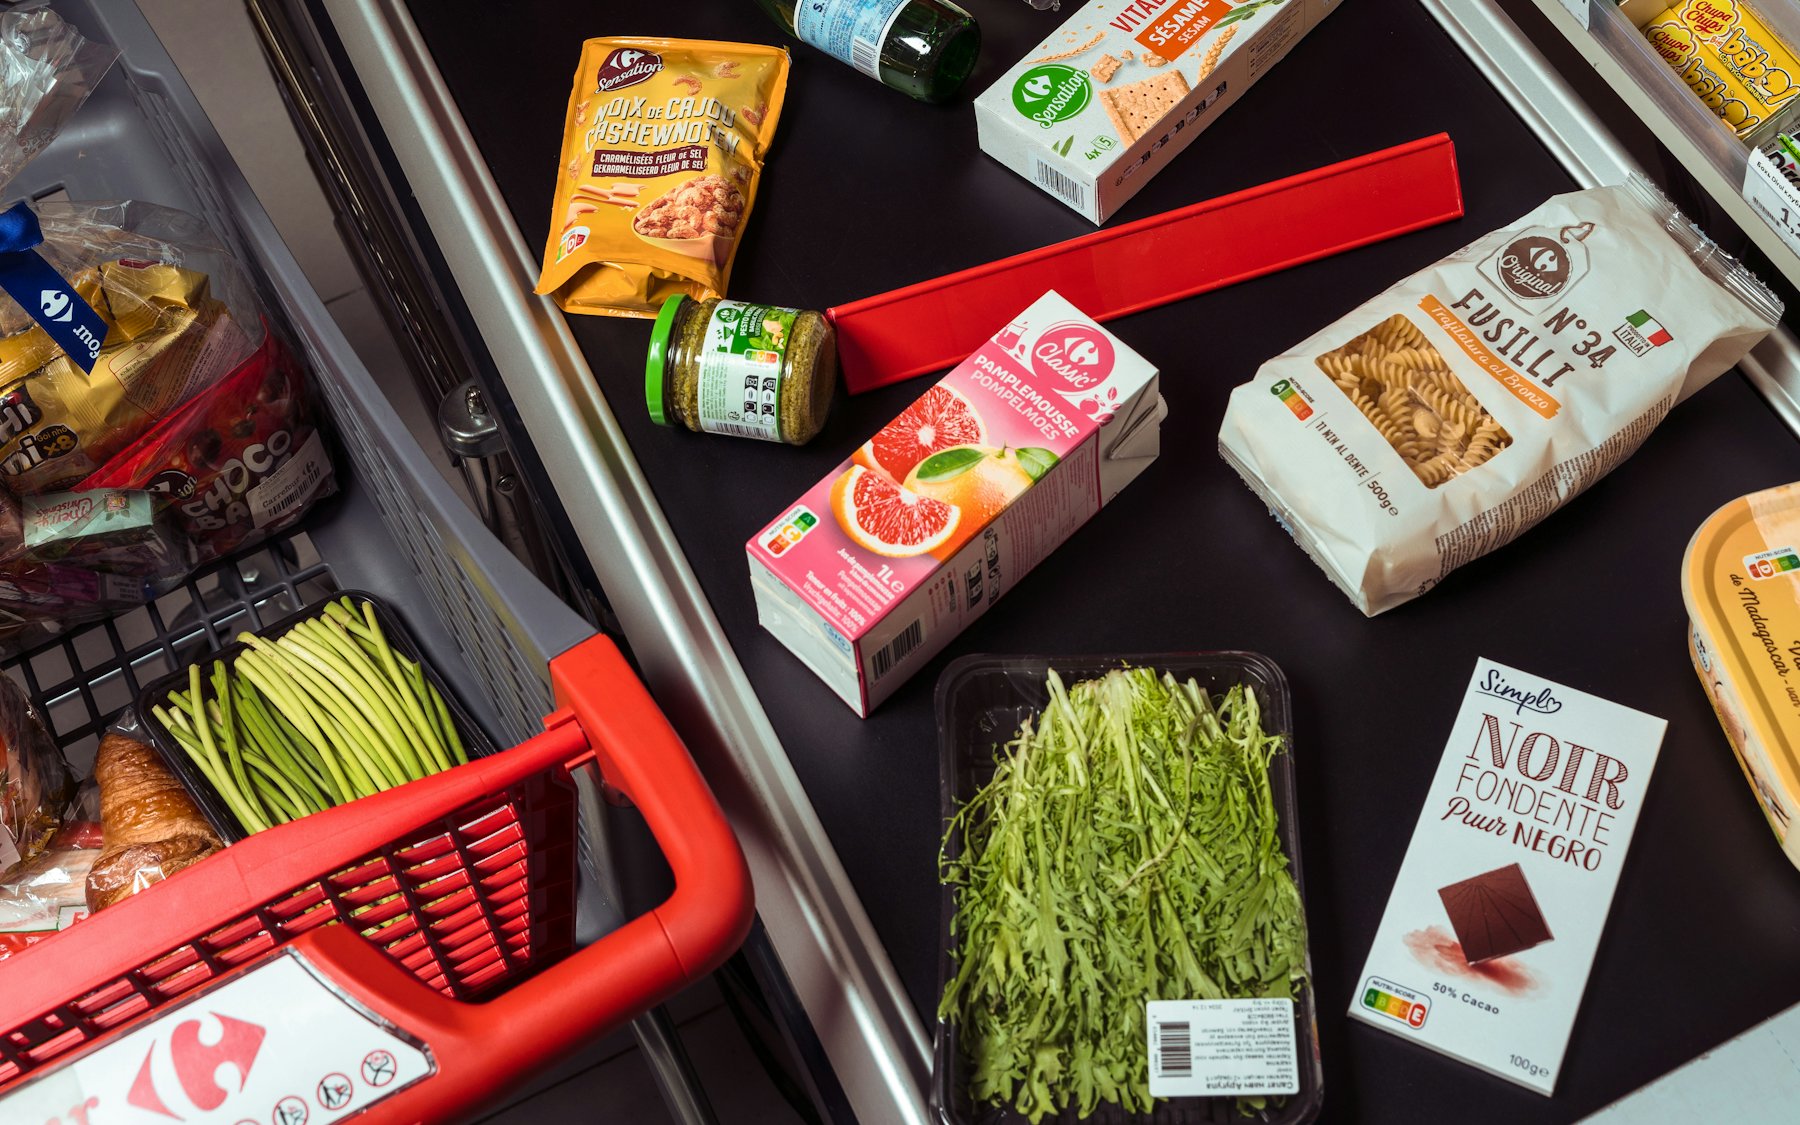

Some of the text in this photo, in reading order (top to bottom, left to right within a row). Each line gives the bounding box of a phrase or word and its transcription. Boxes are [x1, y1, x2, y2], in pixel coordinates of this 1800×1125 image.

[1149, 0, 1210, 46] SÉSAME
[1686, 10, 1725, 33] Chups
[1695, 1, 1733, 22] Chupa
[1178, 15, 1212, 44] SESAM
[1654, 31, 1692, 53] Chupa
[595, 58, 664, 94] Sensation
[594, 96, 737, 129] NOIX DE CAJOU
[1033, 70, 1090, 129] Sensation
[585, 120, 741, 157] CASHEWNOTEN
[1084, 137, 1112, 161] 4x 5
[593, 160, 705, 176] GEKARAMELLISEERD FLEUR DE SEL
[600, 153, 653, 165] CARAMÉLISÉES
[656, 152, 676, 164] FLEUR
[690, 149, 703, 160] SEL
[1500, 254, 1562, 297] Original
[1450, 288, 1576, 388] FUSILLI
[1543, 307, 1617, 370] N°34
[1620, 329, 1644, 354] ITALIA
[1627, 325, 1647, 344] PRODOTTO
[1430, 305, 1550, 410] Trafilatura al Bronzo
[974, 354, 1079, 439] PAMPLEMOUSSE
[1288, 376, 1315, 404] NUTRI-SCORE
[970, 369, 1061, 441] POMPELMOES
[43, 434, 73, 457] x8
[1322, 430, 1341, 446] MIN
[1335, 444, 1348, 456] AL
[1344, 453, 1369, 478] DENTE
[182, 430, 291, 517] CHOCO
[262, 475, 300, 508] Carrefour
[1367, 480, 1391, 509] 500g
[196, 501, 250, 530] BA
[768, 508, 801, 536] NUTRI-SCORE
[837, 548, 849, 560] Jus
[1755, 547, 1792, 560] NUTRI-SCORE
[877, 564, 894, 585] 1L
[841, 614, 859, 633] 100%
[847, 608, 867, 627] 100%
[1730, 573, 1744, 587] de
[1738, 588, 1790, 678] Madagascar
[1466, 712, 1629, 810] NOIR
[1456, 763, 1615, 846] FONDENTE
[1441, 796, 1602, 872] Puur NEGRO
[1372, 979, 1416, 1000] NUTRI-SCORE
[1432, 981, 1500, 1016] 50% Cacao
[1508, 1053, 1538, 1076] 100g
[1268, 1081, 1294, 1089] Салат
